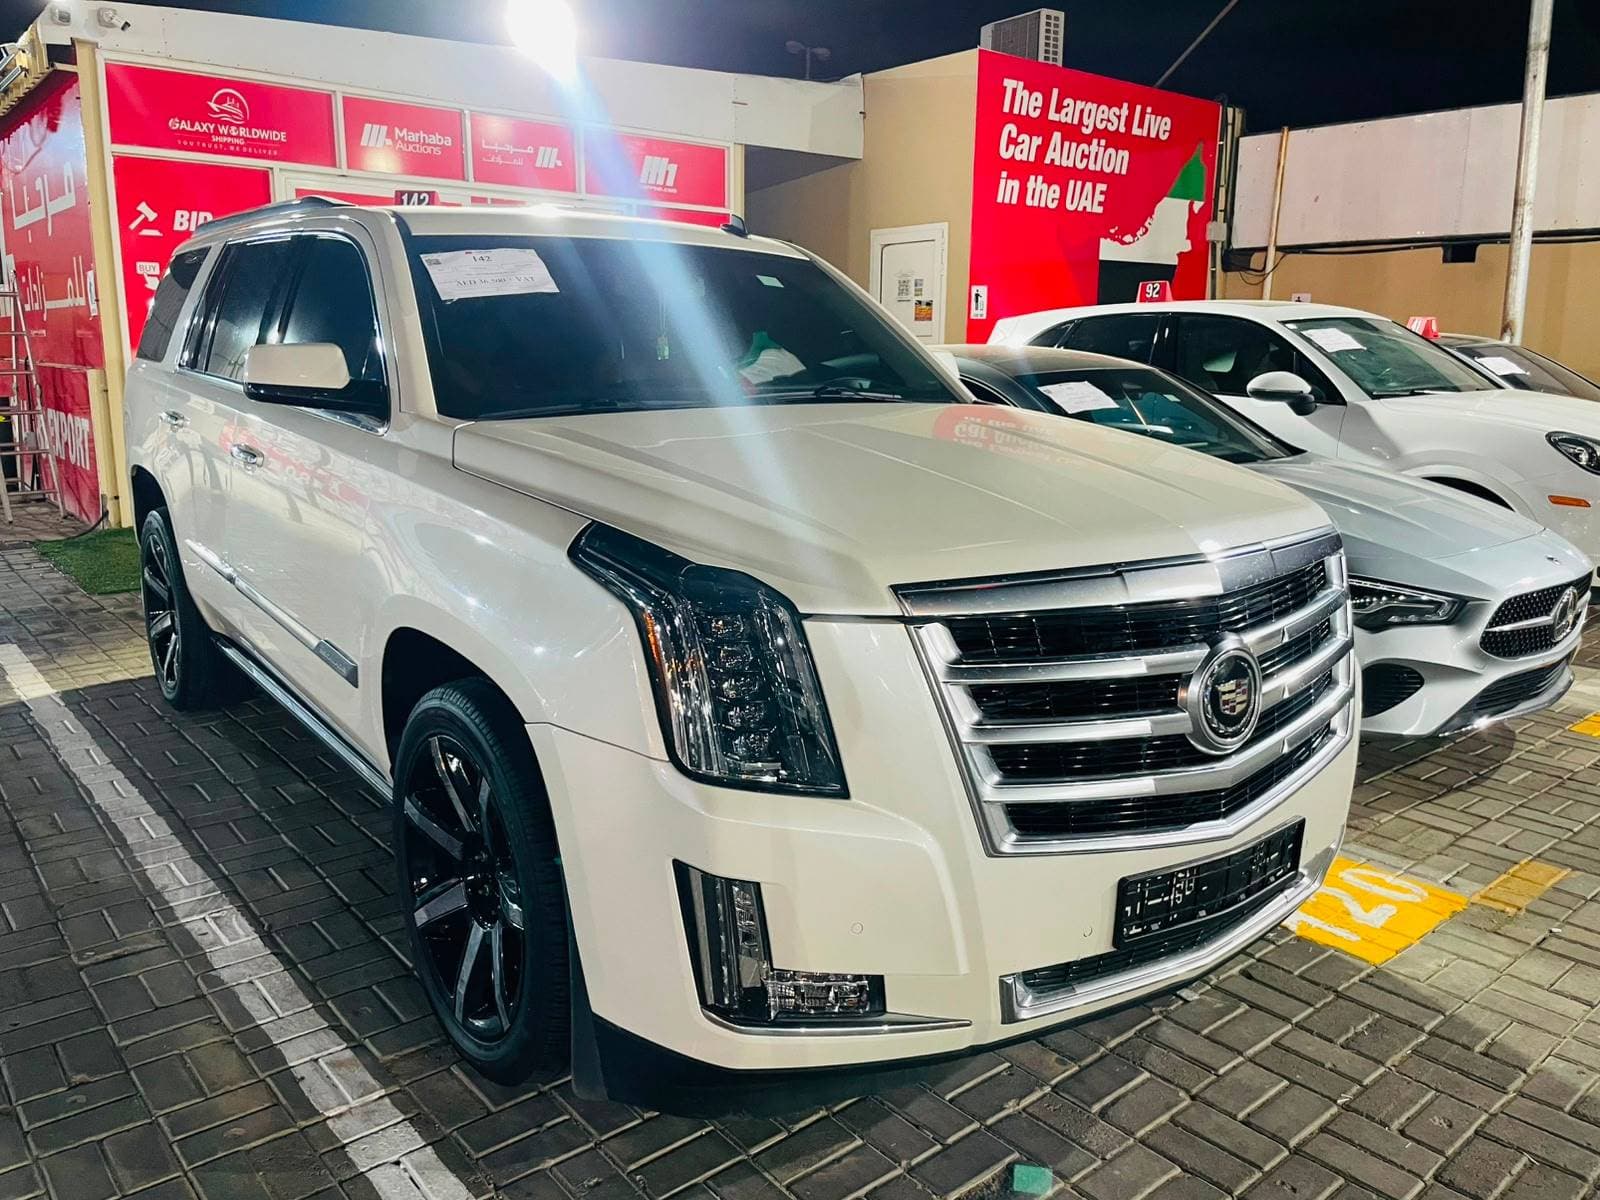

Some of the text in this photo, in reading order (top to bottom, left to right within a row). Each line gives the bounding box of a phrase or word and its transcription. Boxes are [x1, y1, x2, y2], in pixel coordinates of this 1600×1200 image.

[1002, 77, 1172, 141] The Largest Live
[168, 117, 288, 142] GALAXY WORLDWIDE
[394, 126, 453, 146] Marhaba
[211, 135, 246, 145] SHIPPING
[395, 140, 442, 155] Auctions
[999, 123, 1130, 175] Car Auction
[401, 192, 430, 207] 142
[996, 171, 1108, 214] in the UAE
[138, 264, 157, 272] BUY
[1145, 283, 1160, 298] 92
